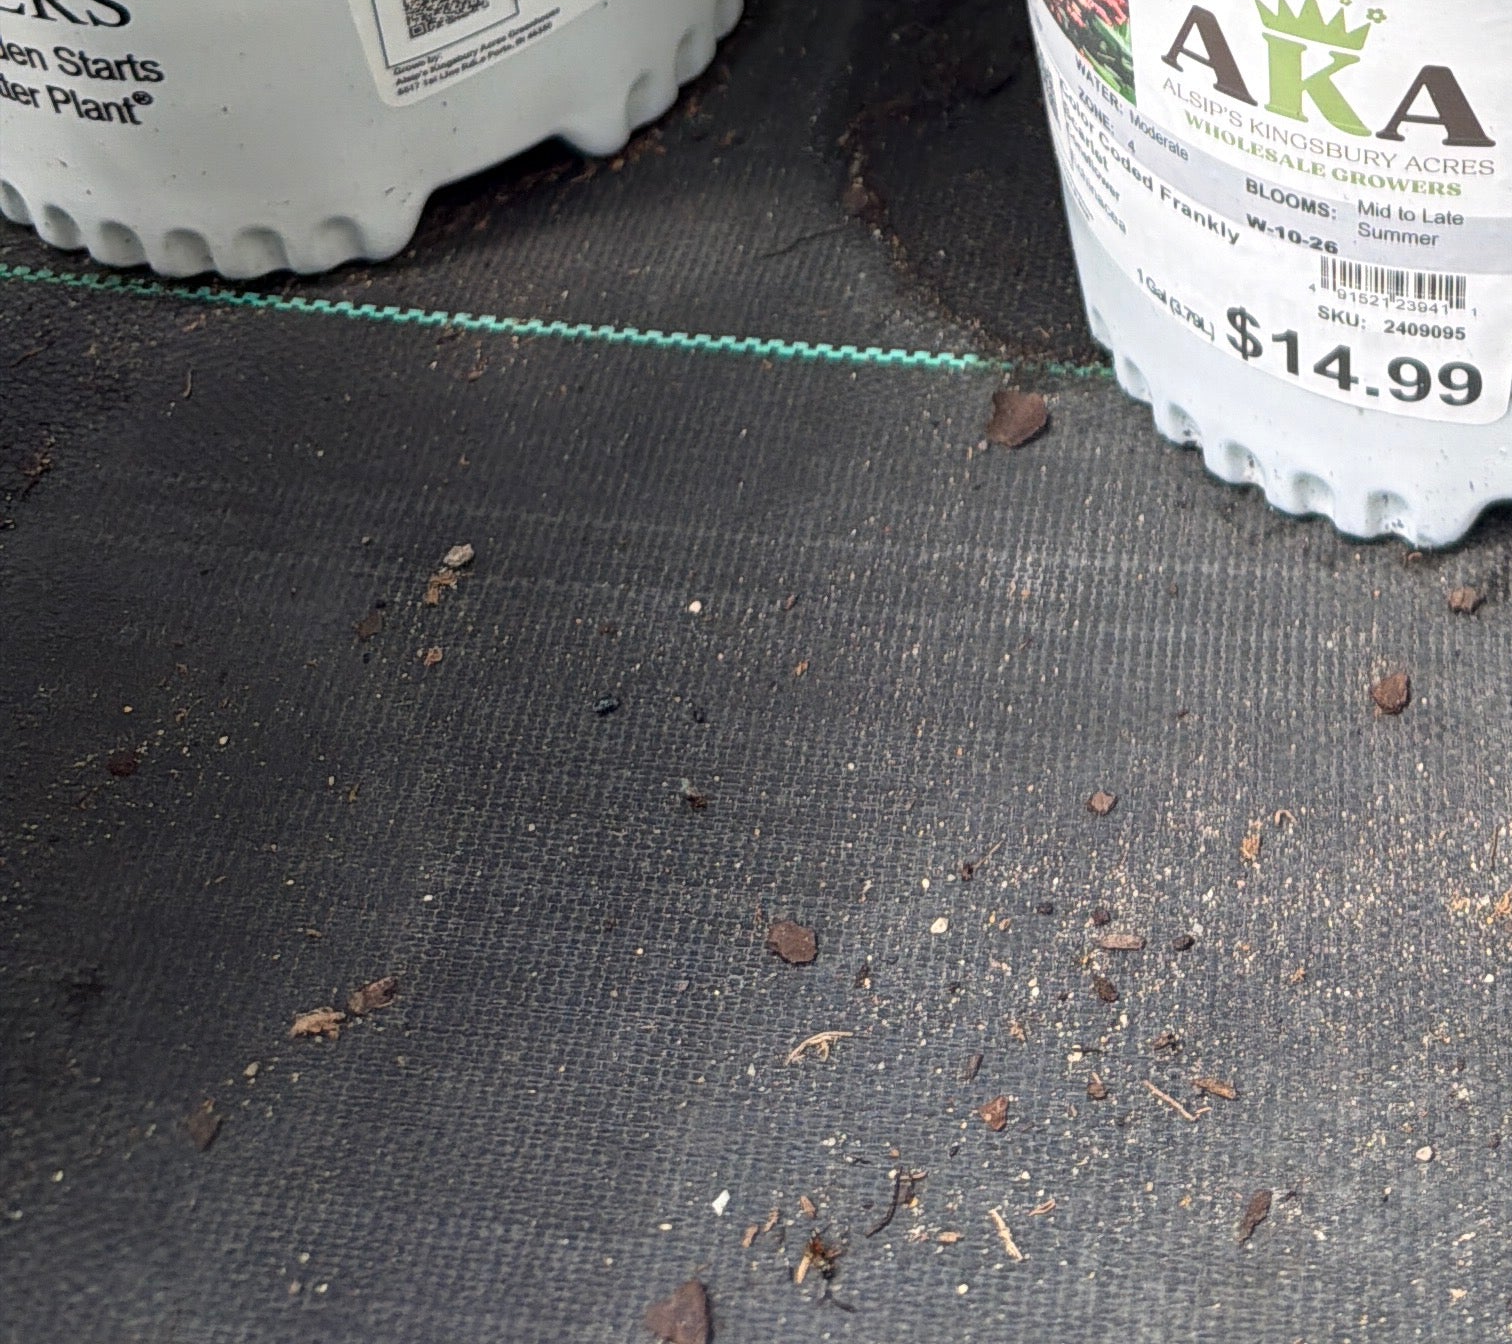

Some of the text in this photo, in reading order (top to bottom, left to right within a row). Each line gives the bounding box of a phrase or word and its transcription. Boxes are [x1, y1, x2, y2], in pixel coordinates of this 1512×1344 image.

[52, 46, 165, 83] Starts
[1161, 5, 1496, 147] AKA
[1075, 53, 1465, 226] WATER: Moderate BLOOMS: Mid to Late
[1162, 76, 1495, 177] ALSIP'S KINGSBURY ACRES
[1184, 109, 1463, 198] WHOLESALE GROWERS
[1099, 130, 1154, 193] Coded
[1160, 183, 1240, 247] Frankly
[1245, 213, 1339, 254] W-10-26
[1357, 221, 1440, 247] Summer
[1225, 305, 1484, 407] $14.99
[1317, 304, 1467, 341] SKU: 2409095
